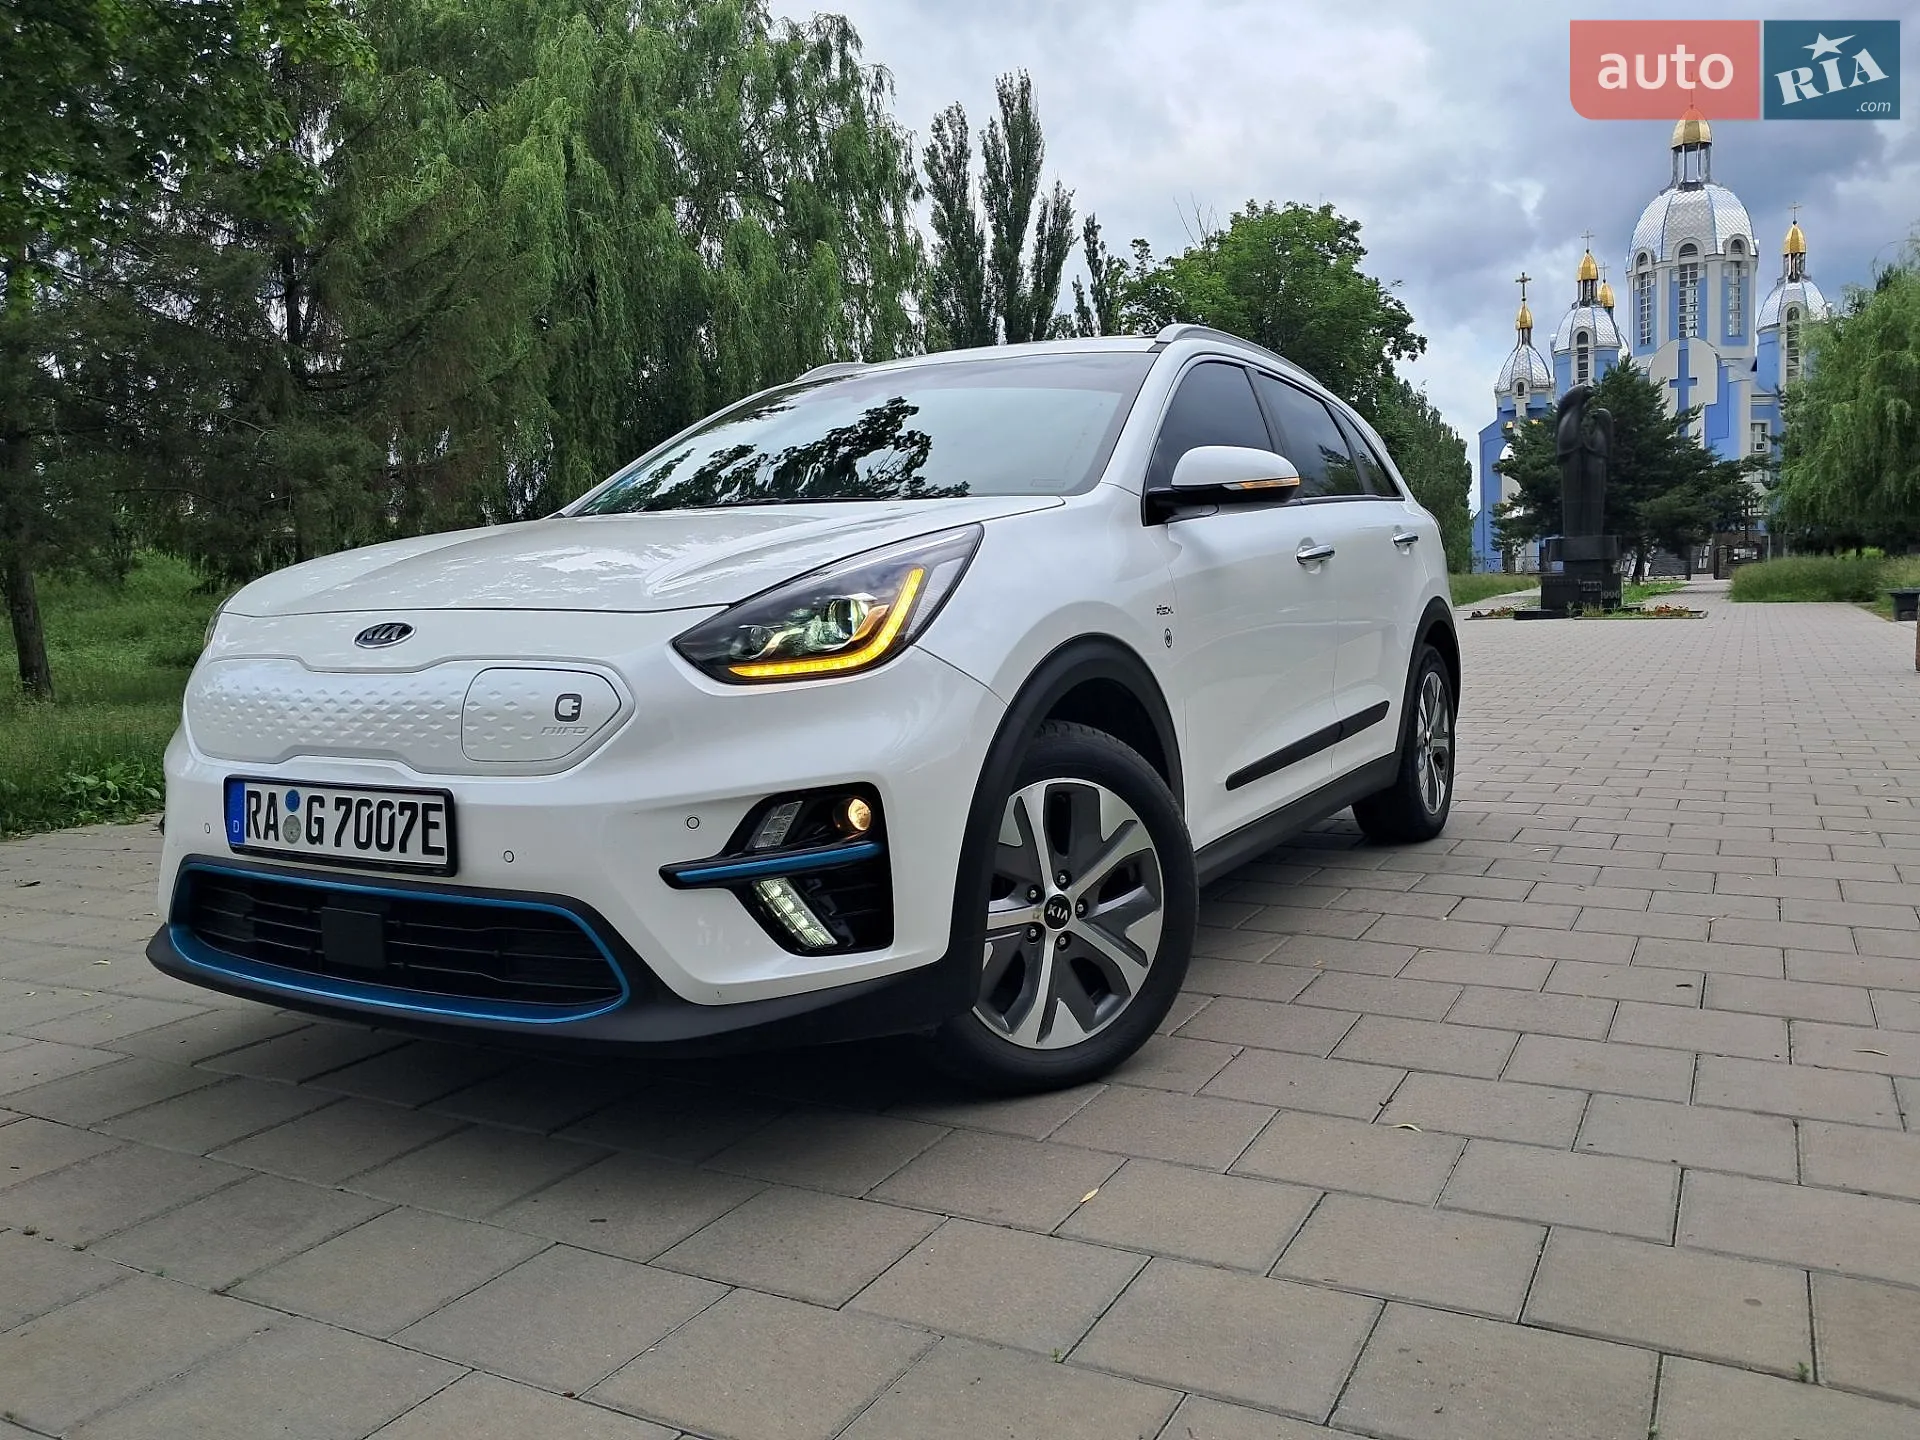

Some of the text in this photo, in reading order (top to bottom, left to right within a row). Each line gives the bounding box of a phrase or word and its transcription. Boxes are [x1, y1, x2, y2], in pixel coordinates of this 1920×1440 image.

[246, 790, 279, 841] RA
[233, 819, 240, 833] D
[1047, 903, 1068, 922] KIA
